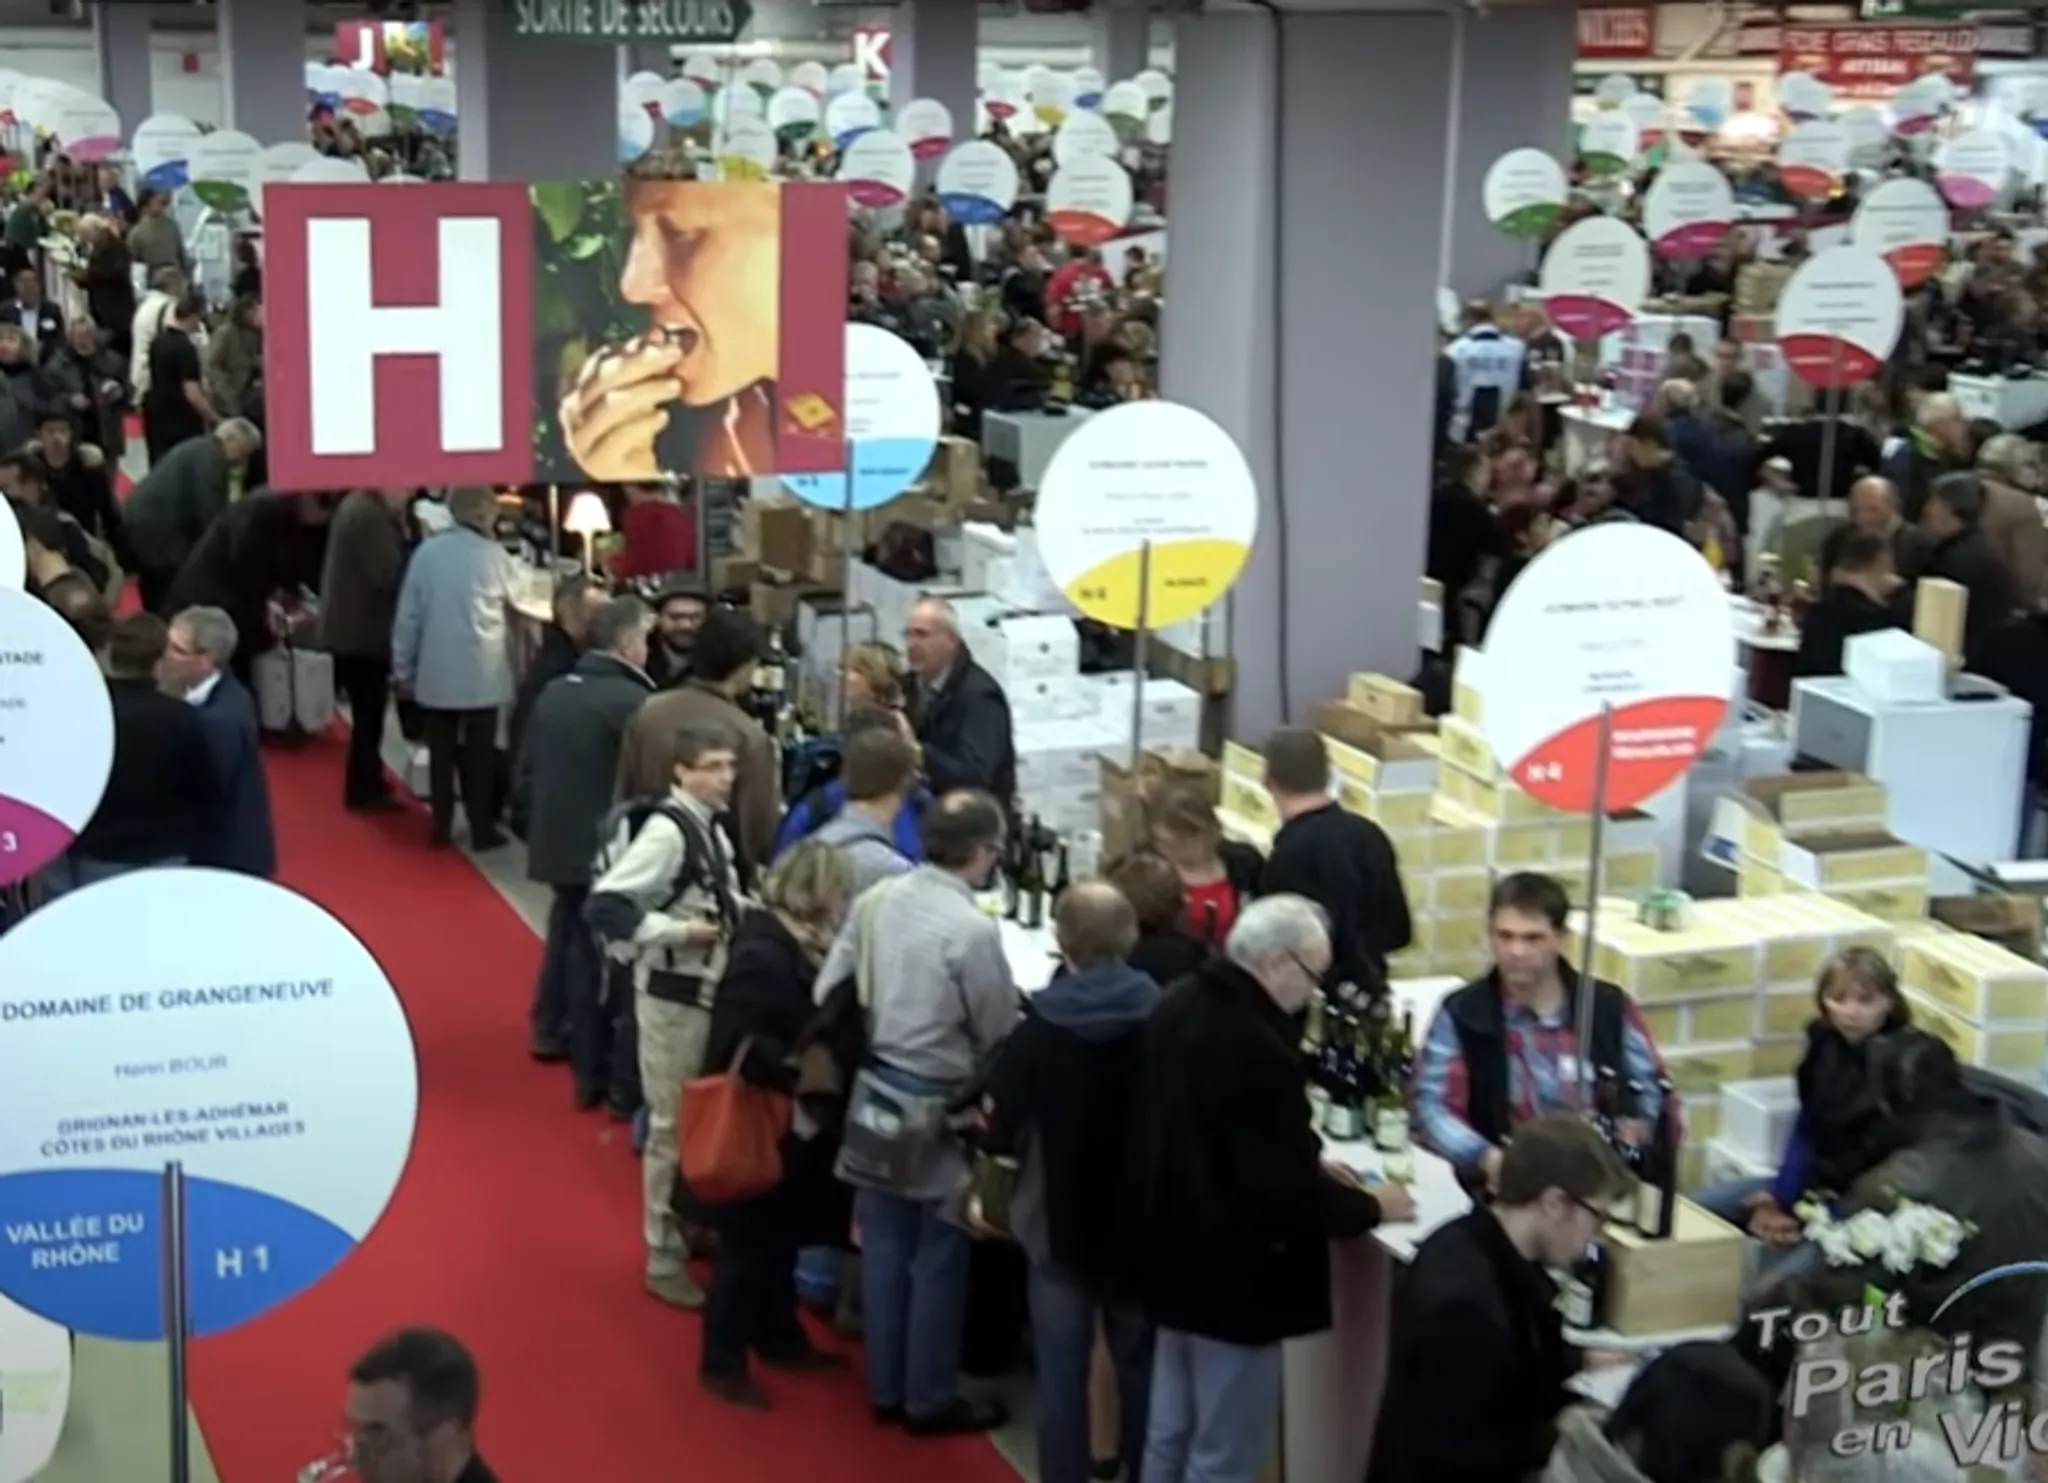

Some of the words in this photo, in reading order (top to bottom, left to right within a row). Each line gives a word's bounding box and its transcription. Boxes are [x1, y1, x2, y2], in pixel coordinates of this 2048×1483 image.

[515, 0, 593, 34] SORTIE
[600, 0, 629, 34] DE
[636, 0, 734, 35] SECOURS
[351, 27, 374, 69] J
[854, 32, 890, 76] K
[307, 216, 503, 455] H
[2, 830, 18, 852] 3
[1, 994, 113, 1022] DOMAINE
[120, 990, 151, 1012] DE
[158, 978, 334, 1009] GRANGENEUVE
[168, 1053, 229, 1075] BOUR
[40, 1136, 105, 1158] CÔTES
[110, 1132, 138, 1151] DU
[143, 1126, 209, 1148] RHÔNE
[216, 1119, 306, 1142] VILLAGES
[6, 1213, 100, 1244] VALLÉE
[108, 1212, 145, 1235] DU
[31, 1241, 121, 1270] RHÔNE
[216, 1248, 243, 1279] H
[253, 1244, 270, 1273] 1
